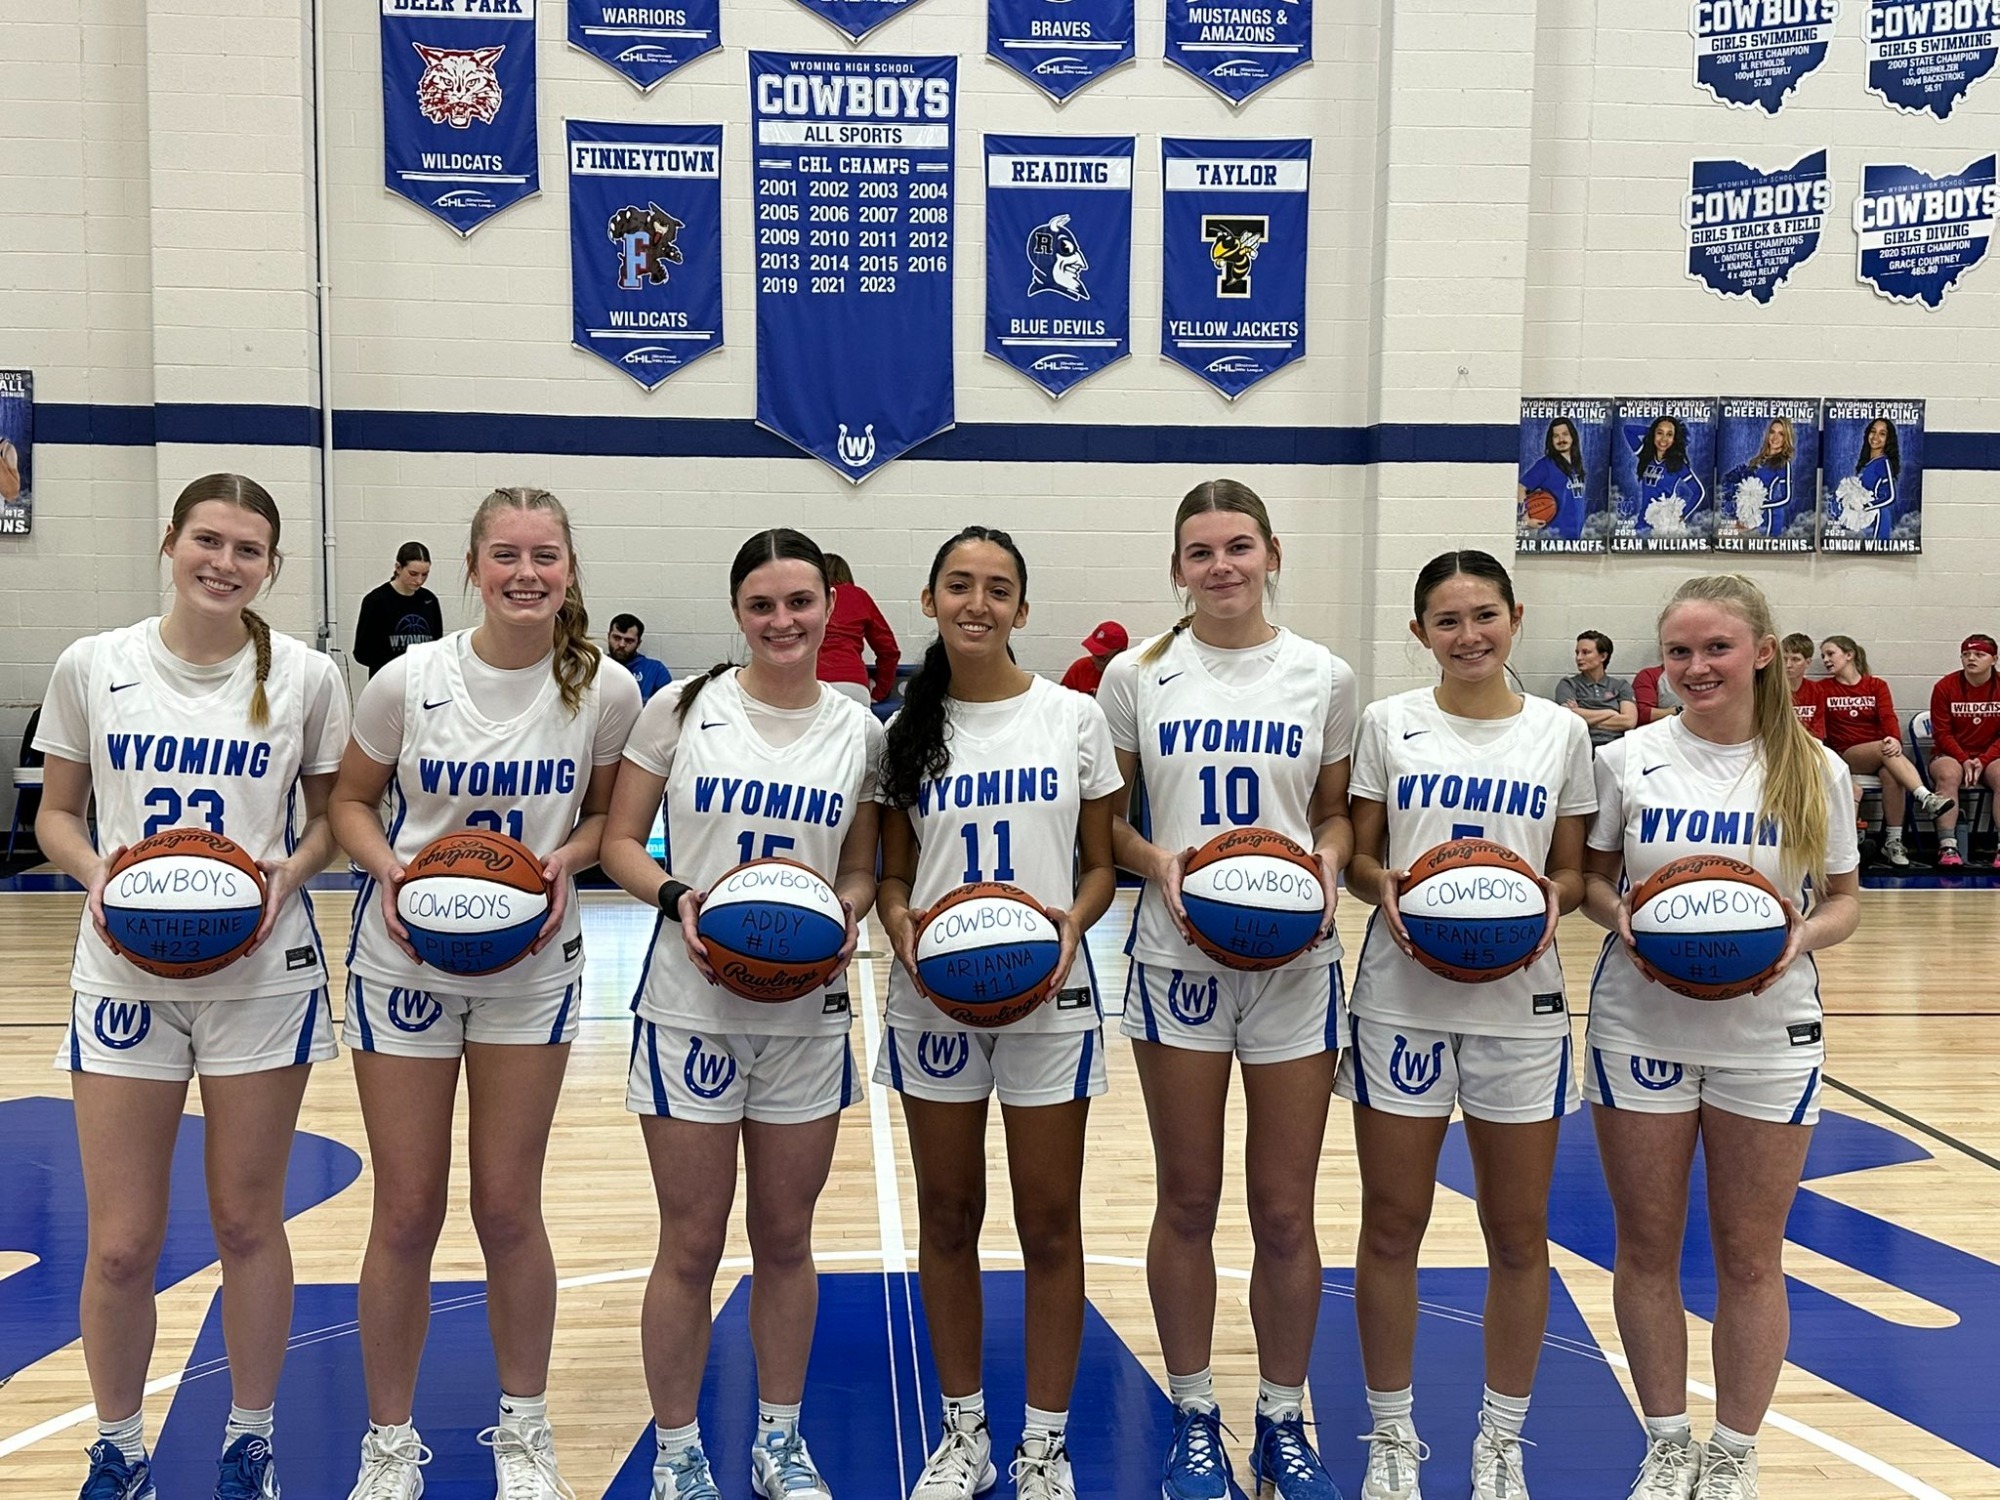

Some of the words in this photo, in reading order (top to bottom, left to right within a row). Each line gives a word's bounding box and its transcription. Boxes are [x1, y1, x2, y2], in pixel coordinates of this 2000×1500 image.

[602, 7, 686, 26] WARRIORS
[1188, 8, 1272, 25] MUSTANGS
[1276, 9, 1288, 25] &
[1031, 20, 1092, 38] BRAVES
[1200, 26, 1276, 43] AMAZONS
[1712, 34, 1747, 52] GIRLS
[1750, 27, 1818, 48] SWIMMING
[1716, 54, 1736, 65] 2001
[1738, 51, 1764, 62] STATE
[1766, 46, 1810, 59] CHAMPION
[1880, 42, 1917, 58] GIRLS
[1921, 33, 1992, 53] SWIMMING
[620, 53, 647, 62] CHL
[790, 60, 841, 71] WYOMING
[844, 62, 871, 72] HIGH
[874, 63, 916, 74] SCHOOL
[1750, 58, 1786, 69] REYNOLDS
[1888, 60, 1908, 70] 2009
[1910, 56, 1934, 68] STATE
[1936, 51, 1980, 65] CHAMPION
[1037, 64, 1064, 74] CHL
[1214, 67, 1240, 77] CHL
[1756, 66, 1792, 79] BUTTERFLY
[1922, 72, 1966, 84] BACKSTROKE
[757, 73, 950, 119] COWBOYS
[804, 126, 834, 143] ALL
[840, 126, 903, 144] SPORTS
[421, 152, 503, 171] WILDCATS
[576, 148, 715, 172] FINNEYTOWN
[798, 156, 833, 174] CHL
[840, 157, 910, 175] CHAMPS
[1011, 162, 1108, 184] READING
[1196, 164, 1278, 187] TAYLOR
[759, 179, 798, 197] 2001
[809, 180, 850, 198] 2002
[858, 182, 899, 199] 2003
[908, 182, 949, 200] 2004
[1686, 180, 1832, 226] COWBOYS
[1858, 184, 2000, 229] COWBOYS
[760, 204, 800, 222] 2005
[809, 205, 850, 223] 2006
[858, 206, 899, 224] 2007
[908, 207, 949, 224] 2008
[760, 228, 800, 246] 2009
[810, 230, 850, 247] 2010
[859, 230, 897, 248] 2011
[908, 231, 949, 249] 2012
[1692, 228, 1728, 245] GIRLS
[1732, 222, 1771, 239] TRACK
[1773, 221, 1783, 232] &
[1784, 216, 1821, 234] FIELD
[1884, 229, 1922, 245] GIRLS
[1926, 224, 1970, 241] DIVING
[1706, 245, 1726, 256] 2000
[1728, 242, 1753, 253] STATE
[1754, 236, 1804, 250] CHAMPIONS
[1879, 248, 1900, 259] 2020
[1900, 245, 1926, 256] STATE
[1928, 240, 1971, 254] CHAMPION
[760, 252, 800, 270] 2013
[810, 254, 850, 272] 2014
[859, 256, 899, 273] 2015
[908, 256, 947, 273] 2016
[1889, 258, 1916, 270] GRACE
[1918, 254, 1961, 268] COURTNEY
[762, 277, 798, 294] 2019
[811, 276, 846, 294] 2021
[860, 276, 896, 293] 2023
[610, 310, 688, 328] WILDCATS
[1010, 320, 1049, 335] BLUE
[1053, 320, 1106, 336] DEVILS
[1168, 320, 1230, 337] YELLOW
[1232, 320, 1299, 338] JACKETS
[1209, 361, 1236, 373] CHL
[1521, 400, 1560, 408] WYOMING
[1561, 400, 1601, 408] COWBOYS
[1522, 408, 1606, 419] HEERLEADING
[1620, 406, 1711, 418] CHEERLEADING
[1626, 400, 1664, 408] WYOMING
[1724, 406, 1814, 419] CHEERLEADING
[1730, 400, 1768, 408] WYOMING
[1770, 400, 1809, 408] COWBOYS
[1829, 408, 1919, 420] CHEERLEADING
[846, 436, 867, 457] W
[1540, 540, 1602, 552] KABAKOFF
[1614, 538, 1643, 551] LEAH
[1648, 538, 1707, 551] WILLIAMS
[1718, 538, 1744, 550] LEXI
[1748, 539, 1808, 551] HUTCHINS
[1824, 539, 1861, 551] LONDON
[1864, 540, 1915, 552] WILLIAMS
[1158, 719, 1304, 759] WYOMING
[107, 734, 272, 778] WYOMING
[420, 758, 576, 797] WYOMING
[694, 776, 844, 828] WYOMING
[917, 767, 1058, 819] WYOMING
[1199, 766, 1260, 826] 10
[1397, 774, 1548, 820] WYOMING
[144, 787, 225, 839] 23
[1640, 808, 1780, 847] WYOMIN
[418, 846, 514, 872] Rawlings
[960, 820, 1015, 884] 11
[120, 868, 237, 899] COWBOYS
[727, 870, 830, 904] COWBOYS
[1212, 868, 1314, 901] COWBOYS
[1426, 877, 1528, 907] COWBOYS
[409, 891, 511, 920] COWBOYS
[1654, 889, 1771, 924] COWBOYS
[125, 916, 243, 938] KATHERINE
[742, 909, 806, 937] ADDY
[934, 906, 1037, 944] COWBOYS
[1234, 916, 1280, 940] LILA
[1424, 922, 1537, 945] FRANCESCA
[150, 940, 201, 958] #23
[426, 938, 494, 959] PIPER
[746, 934, 791, 957] #15
[1229, 935, 1274, 956] #10
[1460, 948, 1496, 964] #5
[1670, 940, 1742, 959] JENNA
[440, 958, 483, 972] #21
[946, 948, 1034, 978] ARIANNA
[1688, 964, 1724, 979] #1
[722, 961, 819, 989] Rawlings
[972, 973, 1020, 998] #11
[109, 1002, 138, 1035] W
[950, 992, 1041, 1024] Rawlings
[932, 1036, 957, 1065] W
[700, 1052, 728, 1085] W
[1404, 1052, 1431, 1082] W
